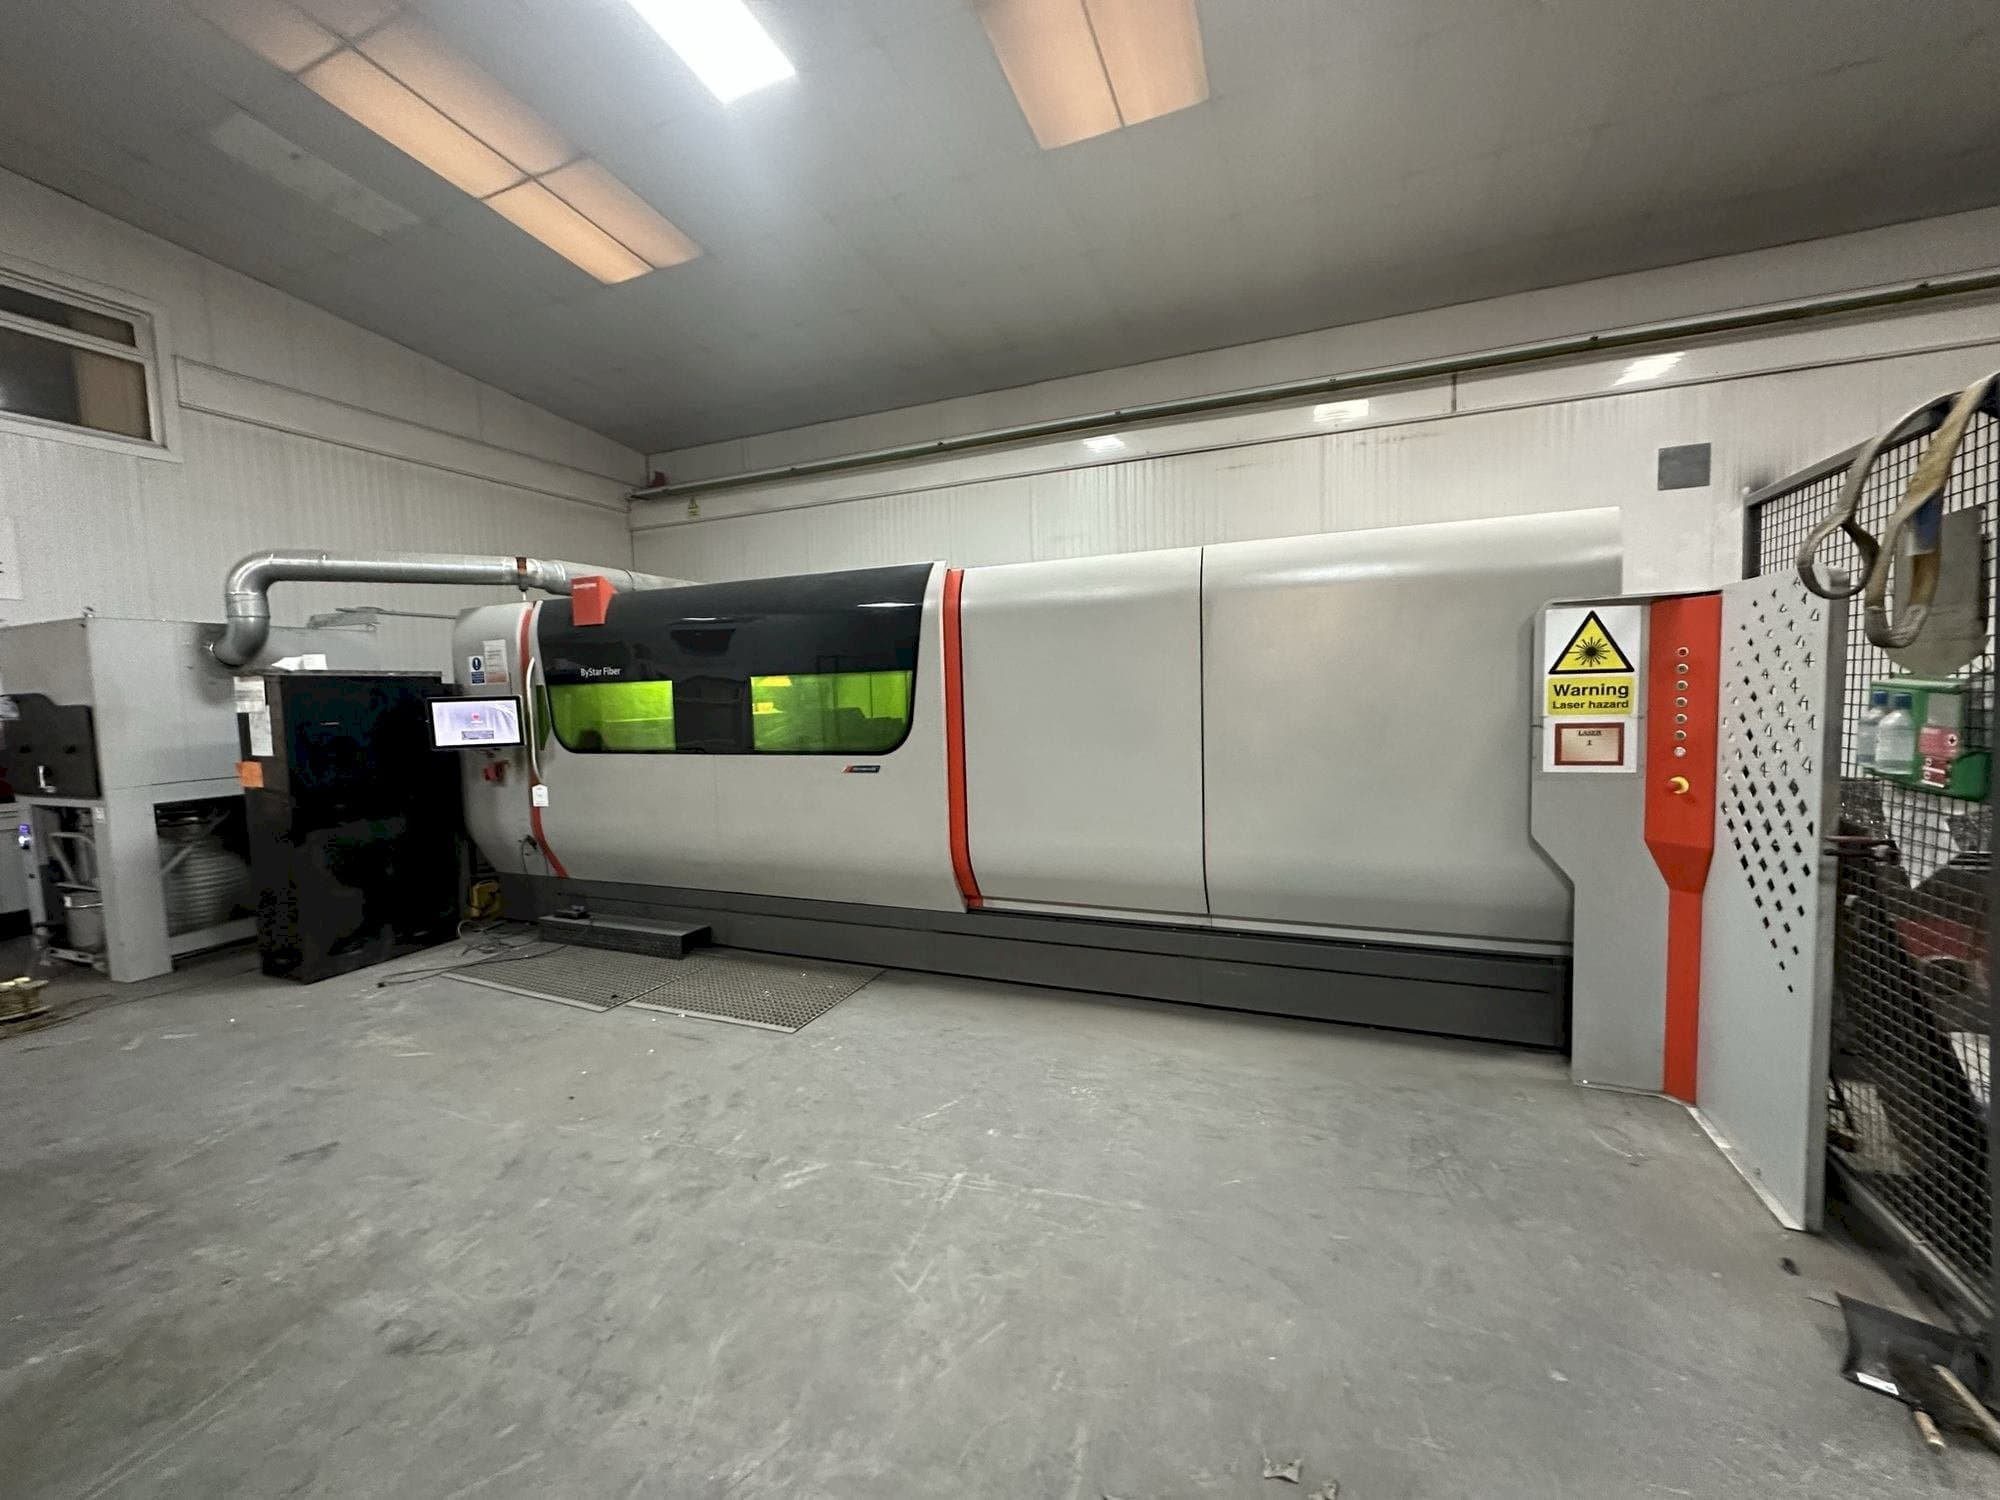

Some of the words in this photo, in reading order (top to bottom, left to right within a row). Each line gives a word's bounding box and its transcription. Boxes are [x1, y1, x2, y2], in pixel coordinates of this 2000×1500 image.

[580, 667, 602, 678] ByStar
[603, 666, 621, 676] Fiber
[1553, 683, 1629, 698] Warning
[1553, 701, 1585, 709] Laser
[1588, 700, 1629, 709] hazard
